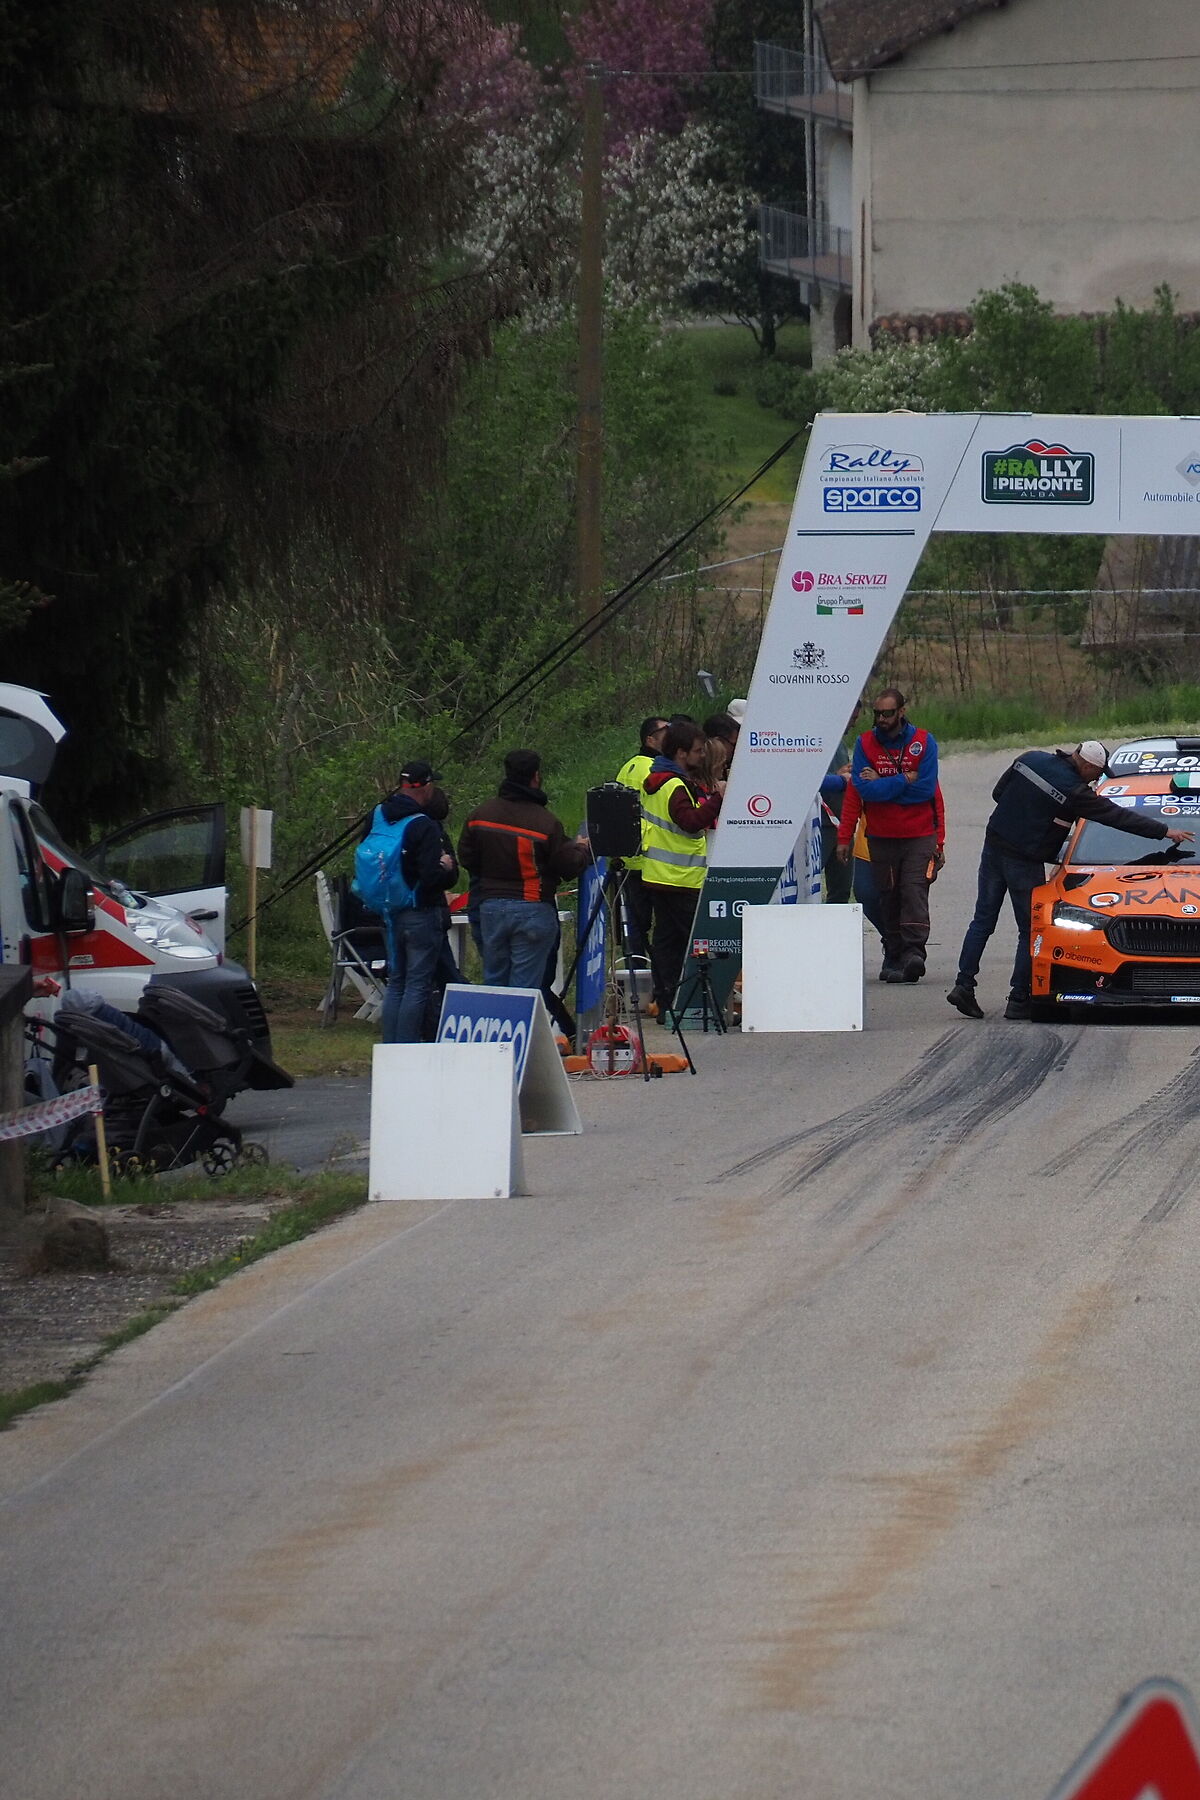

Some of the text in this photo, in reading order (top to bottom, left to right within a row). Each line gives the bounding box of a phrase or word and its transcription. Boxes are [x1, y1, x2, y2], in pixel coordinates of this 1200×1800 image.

[829, 449, 911, 474] Rally
[993, 458, 1083, 477] #RALLY
[820, 475, 861, 483] Campionato
[998, 478, 1083, 491] PIEMONTE
[826, 488, 919, 512] sparco
[1143, 491, 1194, 502] Automobile
[818, 572, 888, 585] BRA SERVIZI
[817, 595, 838, 605] Gruppo
[768, 674, 850, 684] GIOVANNI ROSSO
[749, 731, 816, 746] Biochemic
[1117, 752, 1139, 763] 10
[1107, 786, 1123, 795] 9
[709, 939, 742, 947] REGIONE
